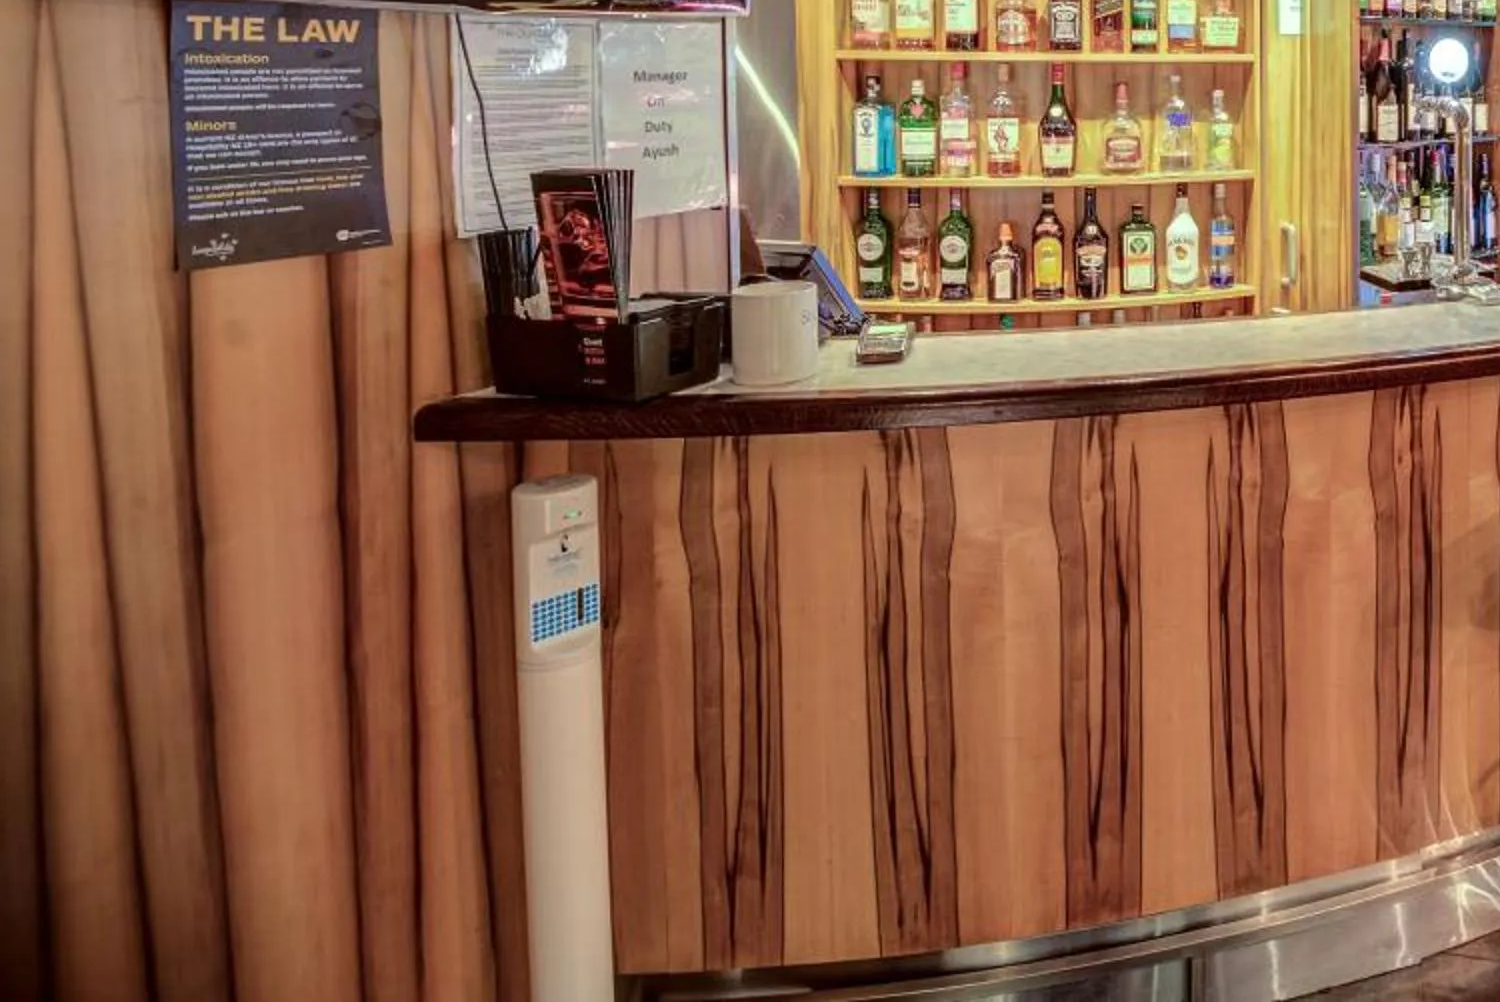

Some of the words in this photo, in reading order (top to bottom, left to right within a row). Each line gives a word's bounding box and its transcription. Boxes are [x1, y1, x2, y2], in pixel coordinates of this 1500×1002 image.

[185, 14, 266, 42] THE
[276, 16, 362, 44] LAW
[184, 53, 270, 65] Intoxication
[632, 69, 688, 85] Manager
[185, 120, 238, 132] Minors
[644, 120, 673, 134] Duty
[642, 143, 680, 161] Ayush
